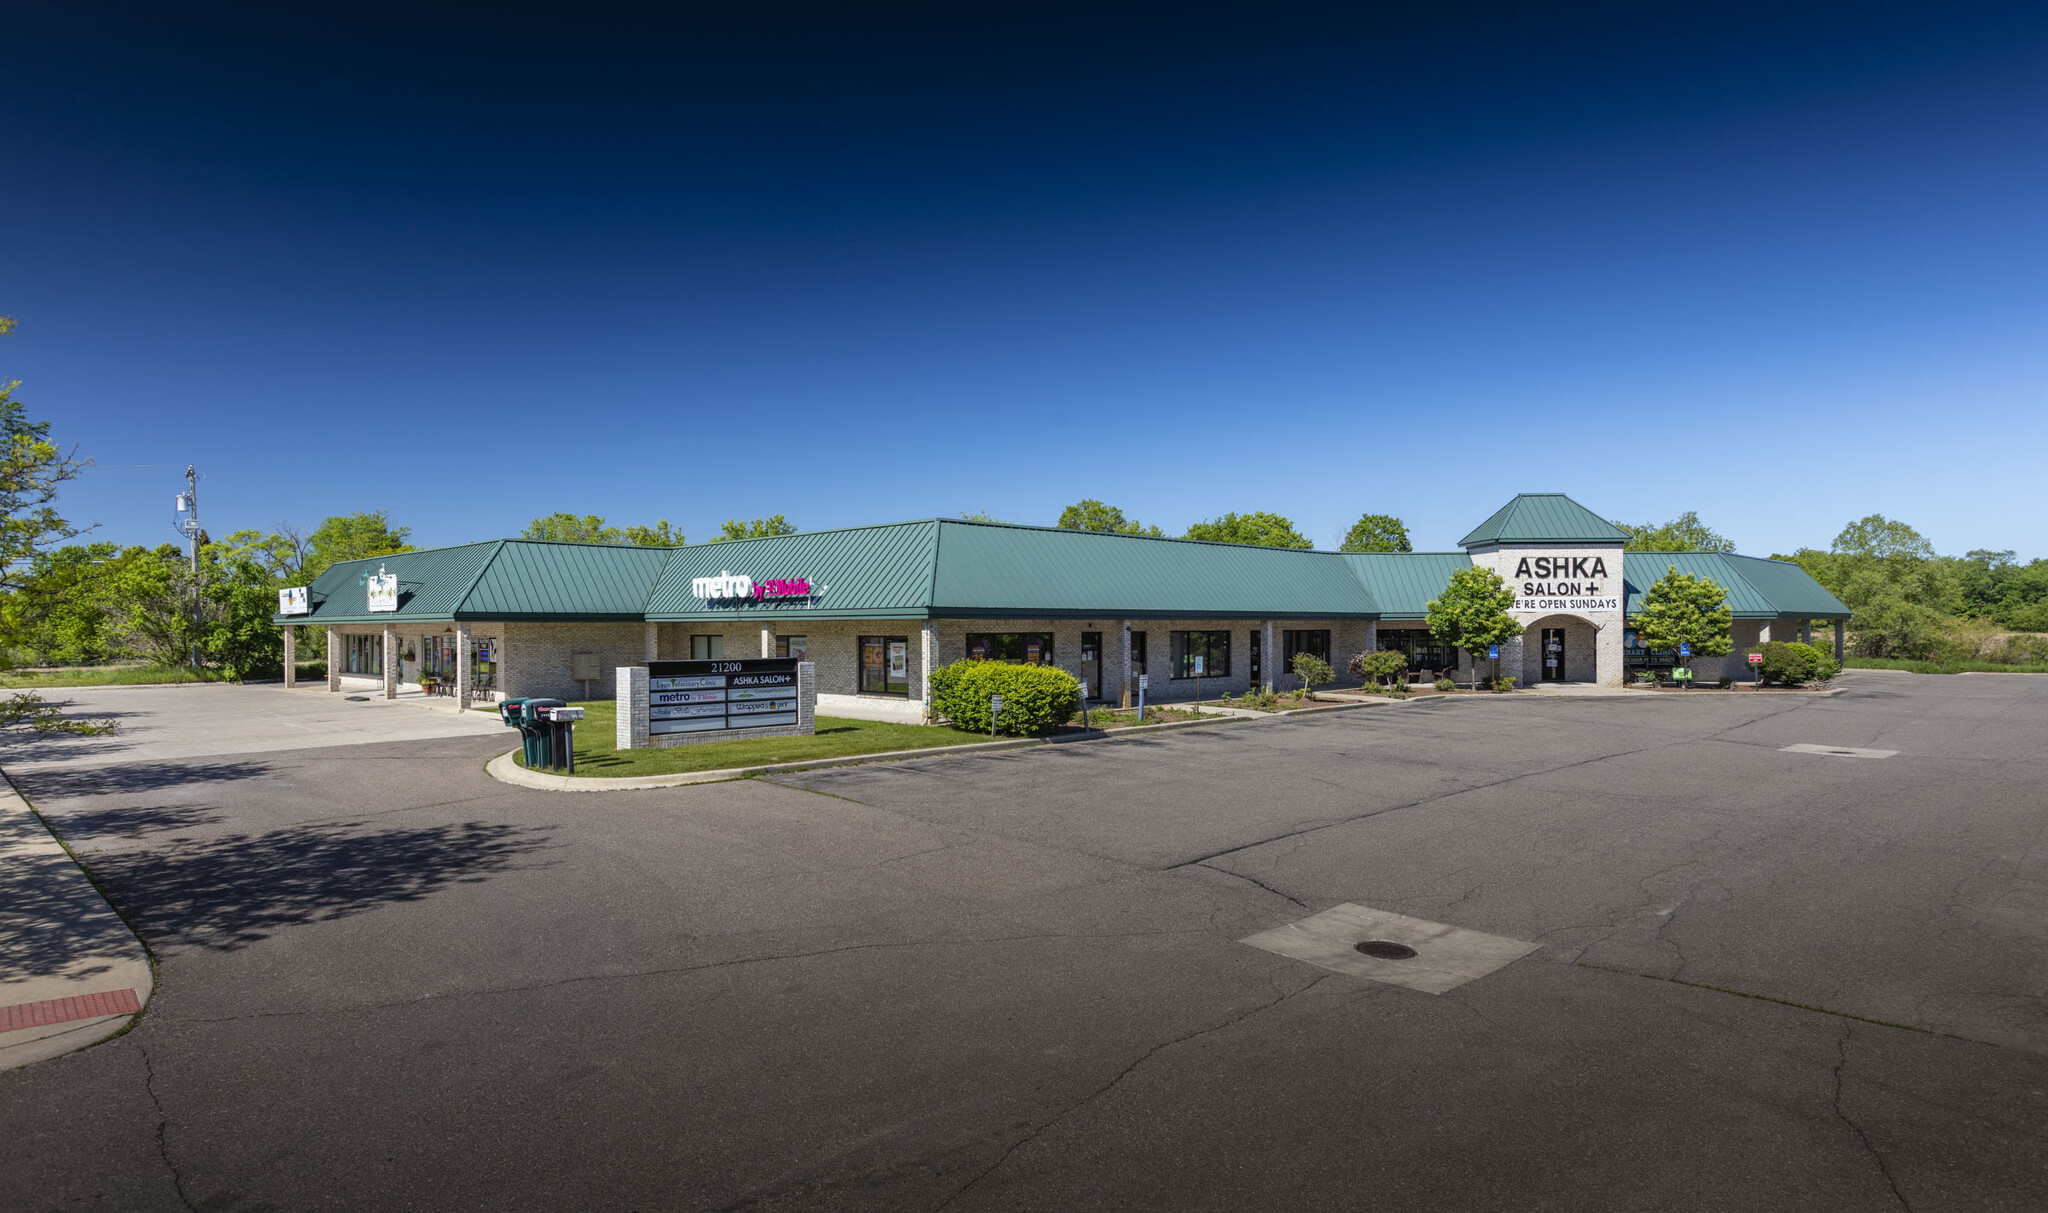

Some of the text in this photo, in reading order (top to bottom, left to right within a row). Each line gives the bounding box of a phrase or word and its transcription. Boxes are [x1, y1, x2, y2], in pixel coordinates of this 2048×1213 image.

[1514, 556, 1608, 579] ASHKA
[692, 570, 752, 599] metro
[752, 581, 765, 602] by
[1538, 599, 1567, 609] OPEN
[1570, 598, 1617, 609] SUNDAYS
[864, 646, 884, 664] 5G
[711, 662, 742, 673] 21200
[699, 677, 717, 687] Clinic
[733, 676, 760, 686] ASHKA
[659, 692, 691, 702] metro
[736, 703, 765, 712] Wrapped
